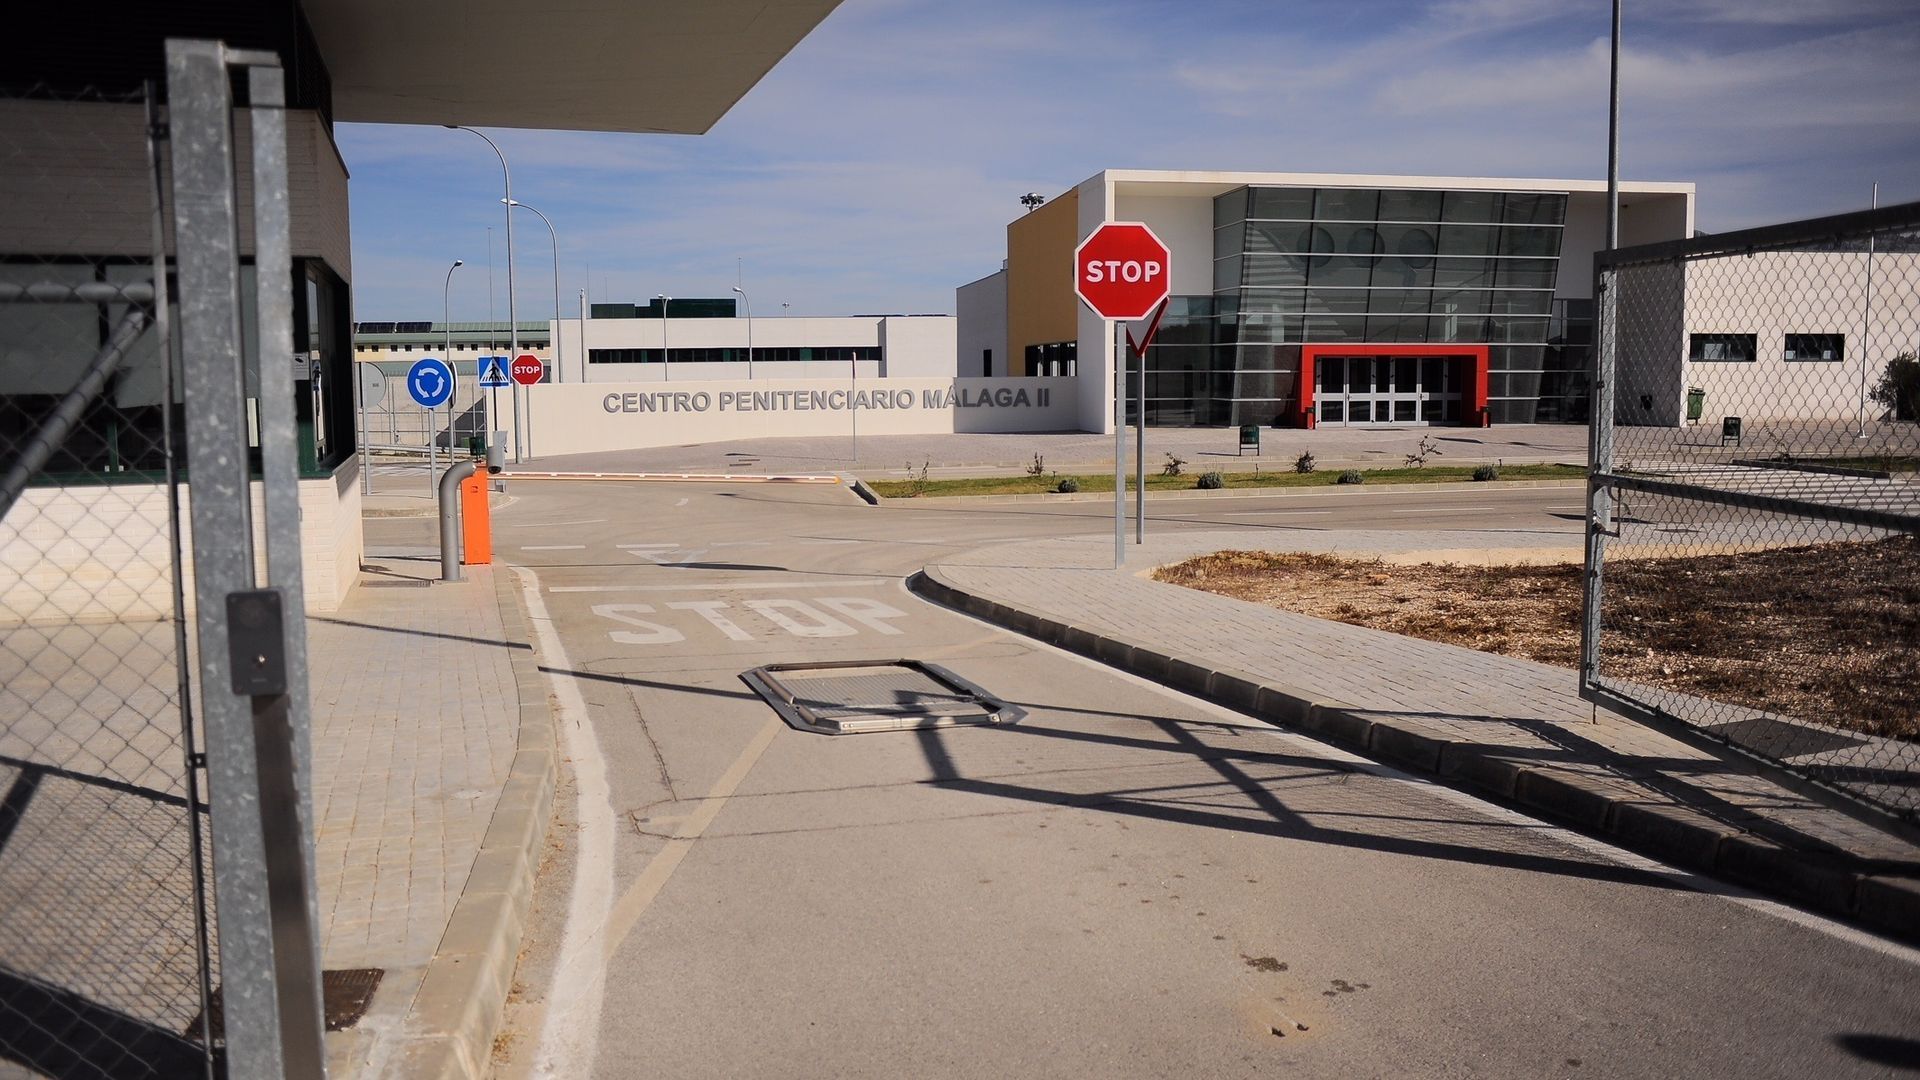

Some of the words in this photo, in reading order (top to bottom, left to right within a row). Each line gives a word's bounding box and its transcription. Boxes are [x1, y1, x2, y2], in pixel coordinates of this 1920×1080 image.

[1086, 260, 1161, 283] STOP
[514, 365, 540, 375] STOP
[603, 391, 712, 413] CENTRO
[719, 389, 916, 412] PENITENCIARIO
[1037, 388, 1050, 407] II
[591, 597, 909, 644] STOP
